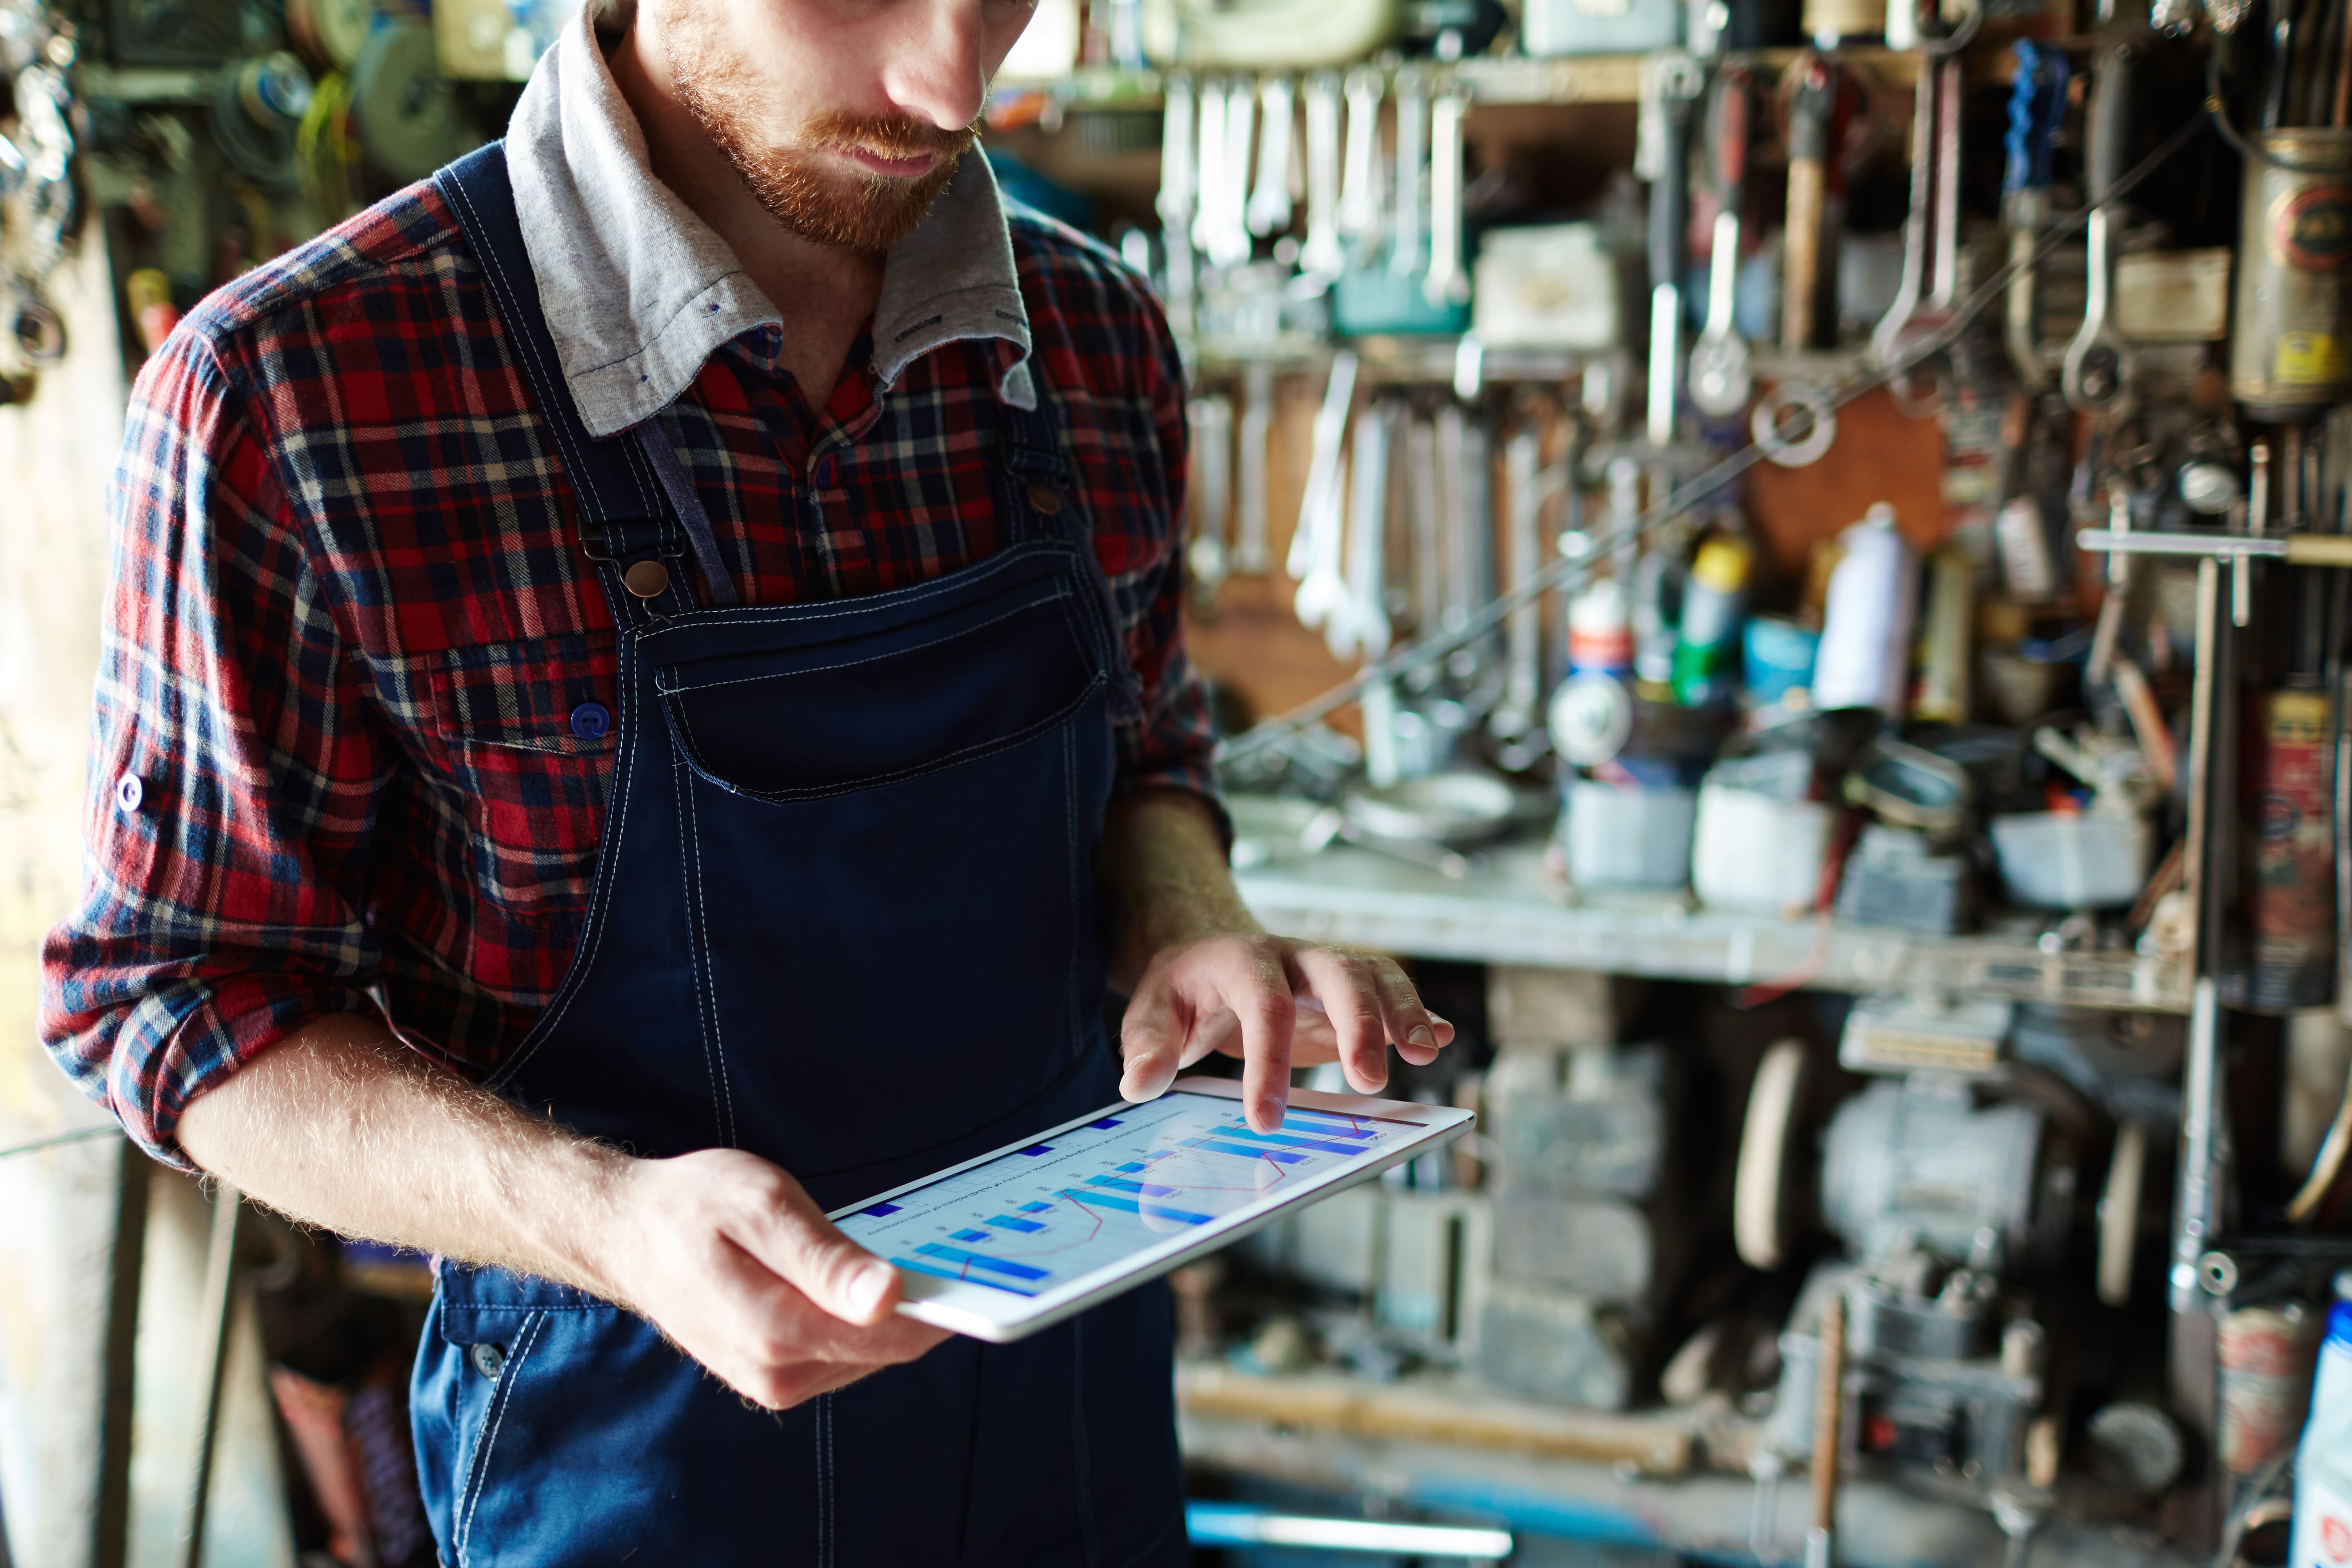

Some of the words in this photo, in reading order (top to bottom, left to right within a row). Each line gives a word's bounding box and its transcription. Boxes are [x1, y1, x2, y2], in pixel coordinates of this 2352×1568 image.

[1066, 1143, 1102, 1157] changing
[1032, 1158, 1068, 1171] business
[1003, 1171, 1031, 1183] activity
[942, 1187, 992, 1206] subdivisions
[909, 1210, 931, 1219] main
[868, 1219, 908, 1235] company
